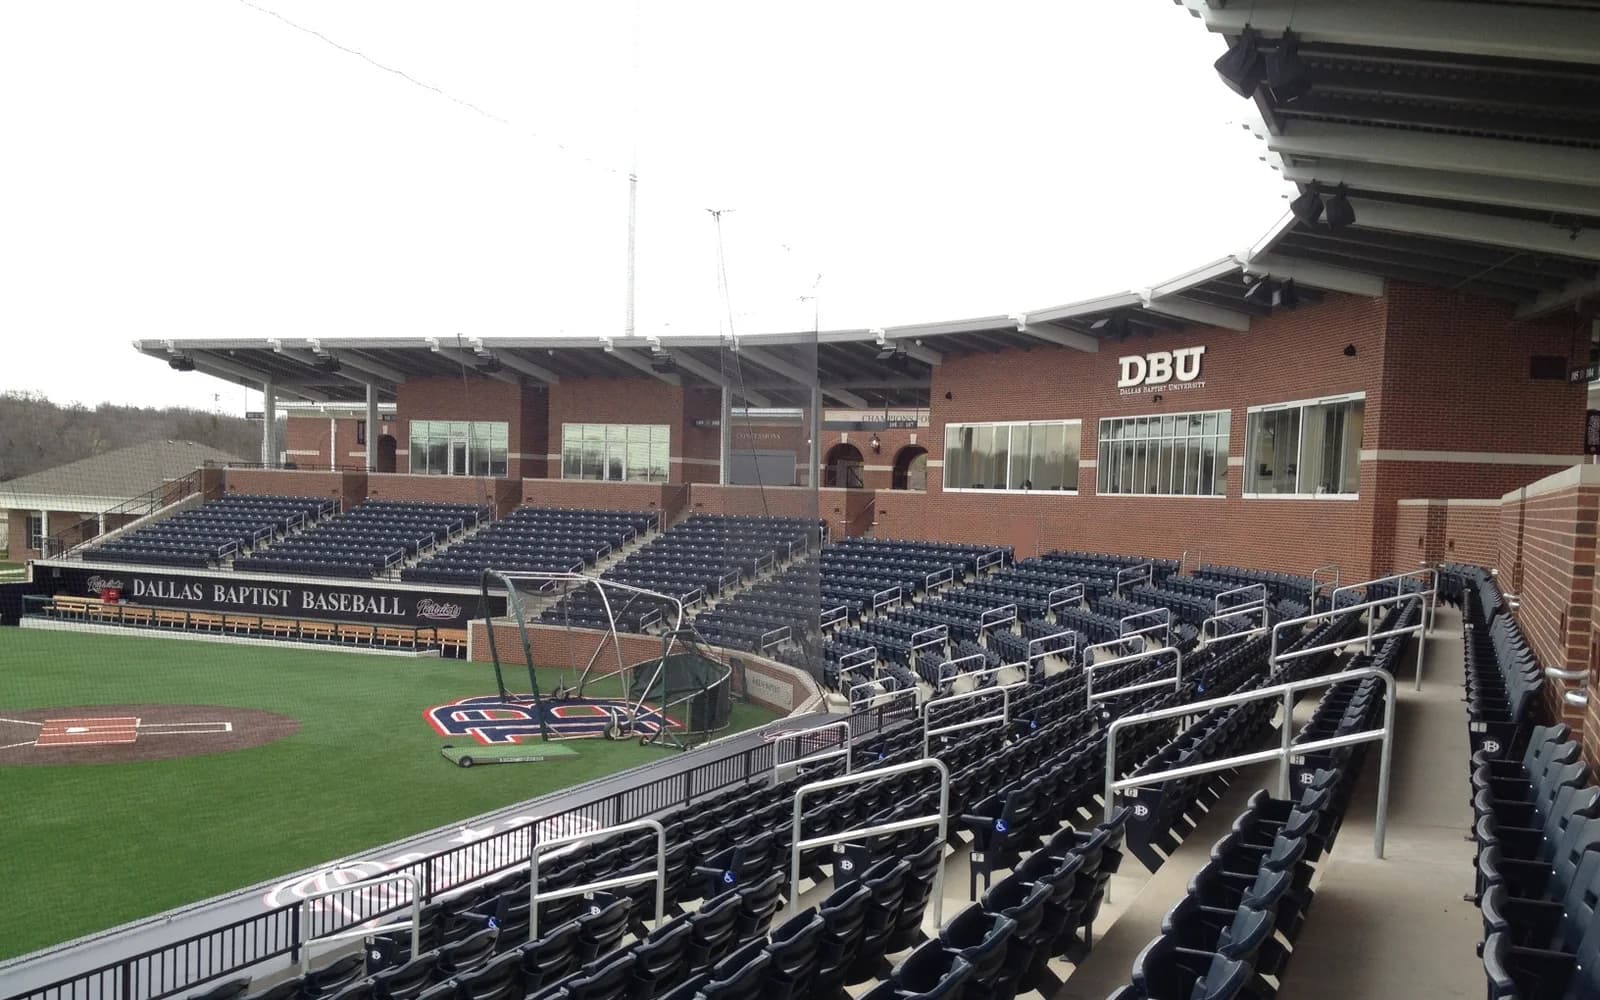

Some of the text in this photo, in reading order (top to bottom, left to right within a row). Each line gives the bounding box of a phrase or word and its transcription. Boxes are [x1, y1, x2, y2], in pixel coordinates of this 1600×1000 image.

[1118, 346, 1205, 388] DBU
[133, 578, 406, 616] DALLAS BAPTIST BASEBALL
[416, 598, 462, 620] Patriots
